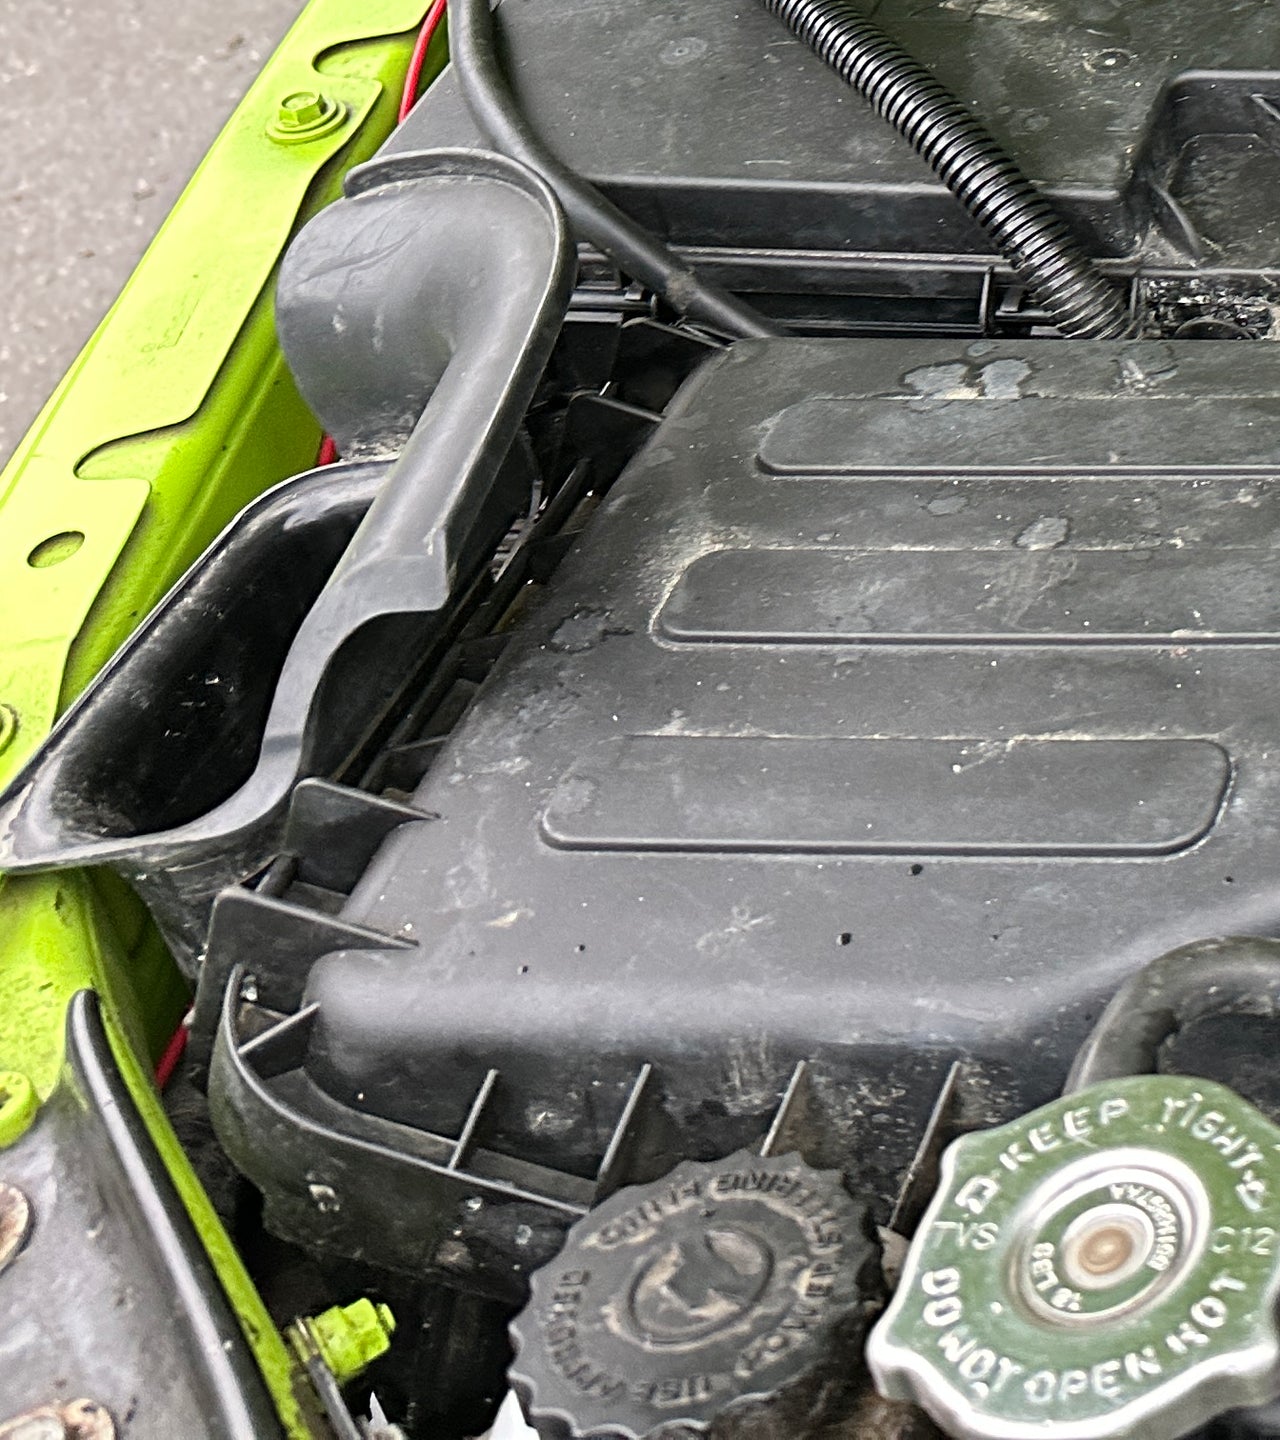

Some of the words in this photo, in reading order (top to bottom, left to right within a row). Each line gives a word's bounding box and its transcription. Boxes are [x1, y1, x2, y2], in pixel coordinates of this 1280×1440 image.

[1000, 1096, 1129, 1171] KEEP
[1162, 1093, 1265, 1170] TIGHT
[922, 1266, 962, 1328] DO
[1165, 1271, 1247, 1355] HOT
[938, 1331, 1023, 1388] NOT
[1023, 1344, 1163, 1404] OPEN
